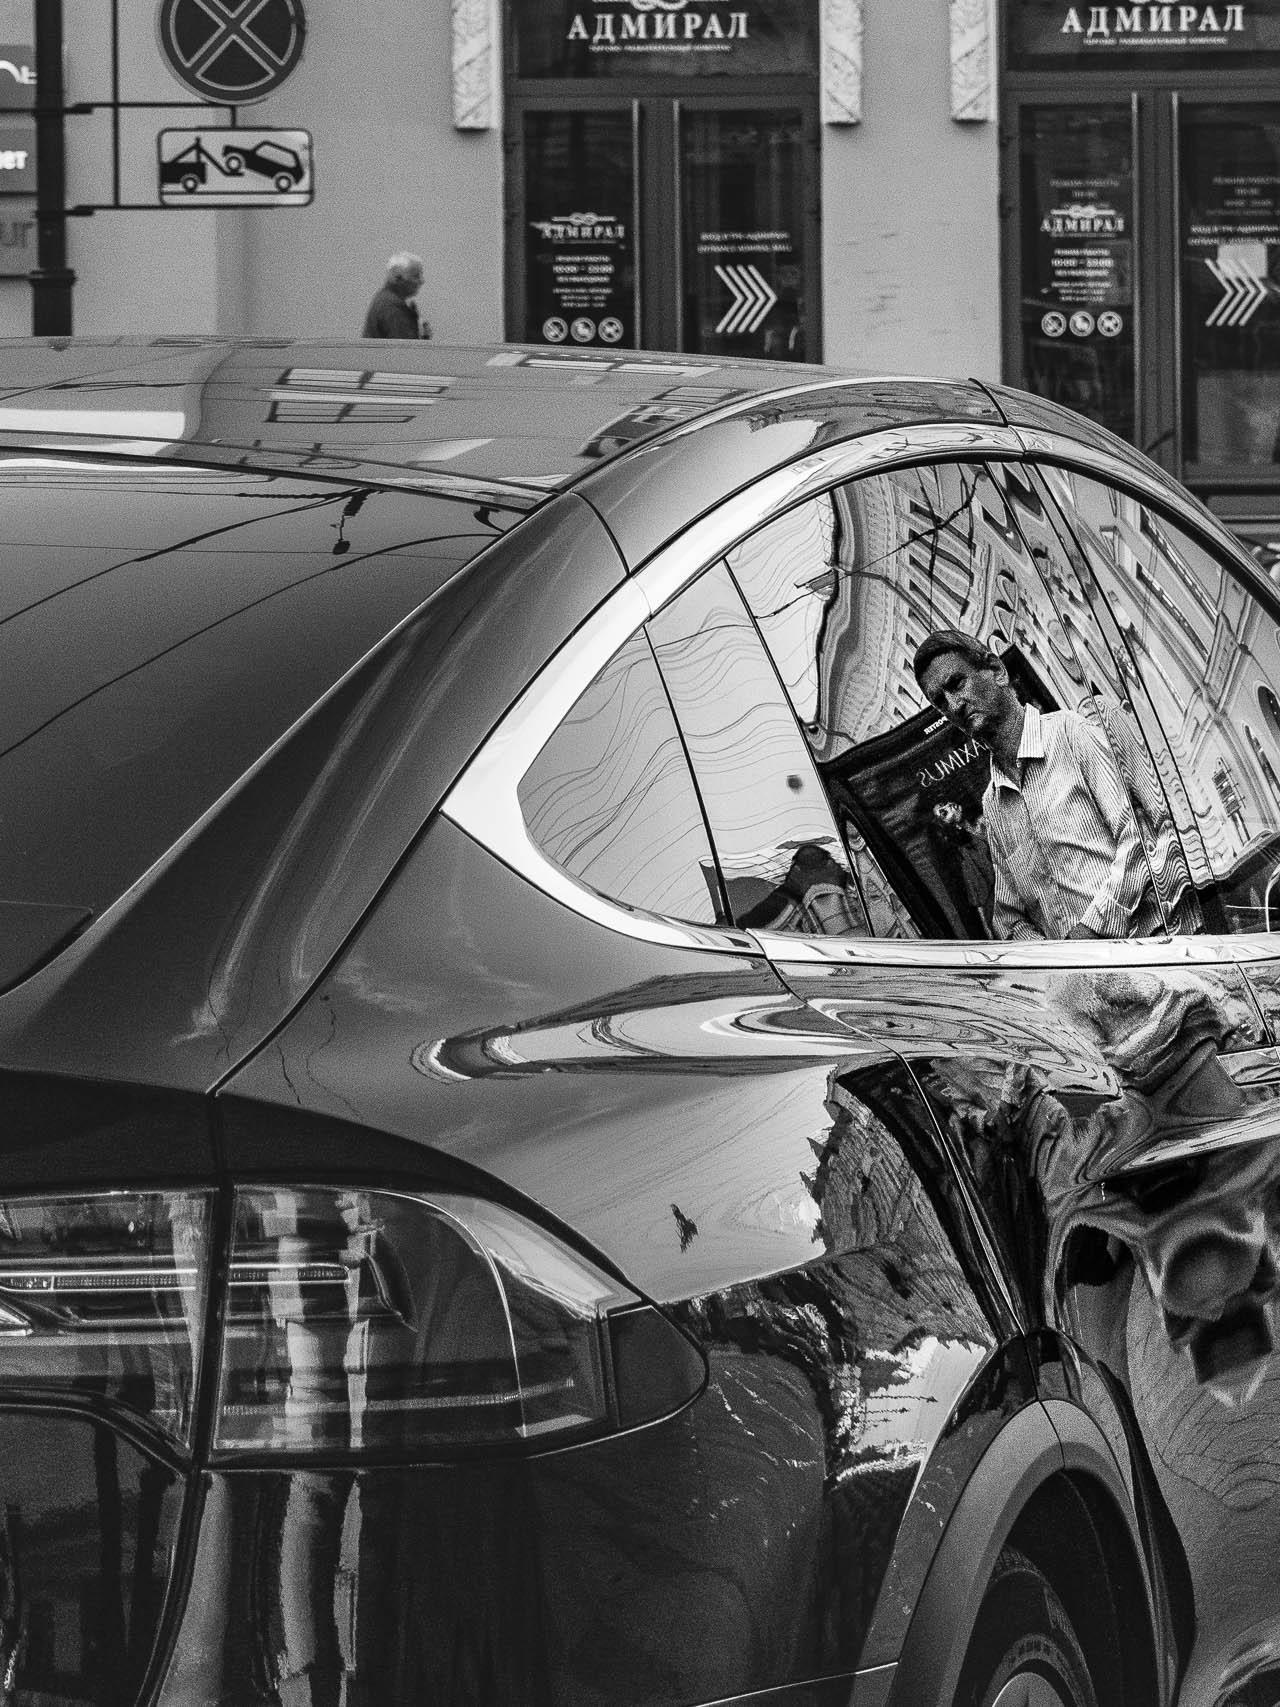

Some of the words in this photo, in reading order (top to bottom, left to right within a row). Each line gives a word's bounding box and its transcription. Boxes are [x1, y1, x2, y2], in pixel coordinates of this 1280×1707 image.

[567, 12, 750, 43] АДМИРАЛ
[1060, 5, 1246, 37] АДМИРАЛ
[1040, 217, 1125, 236] АДМИРАЛ
